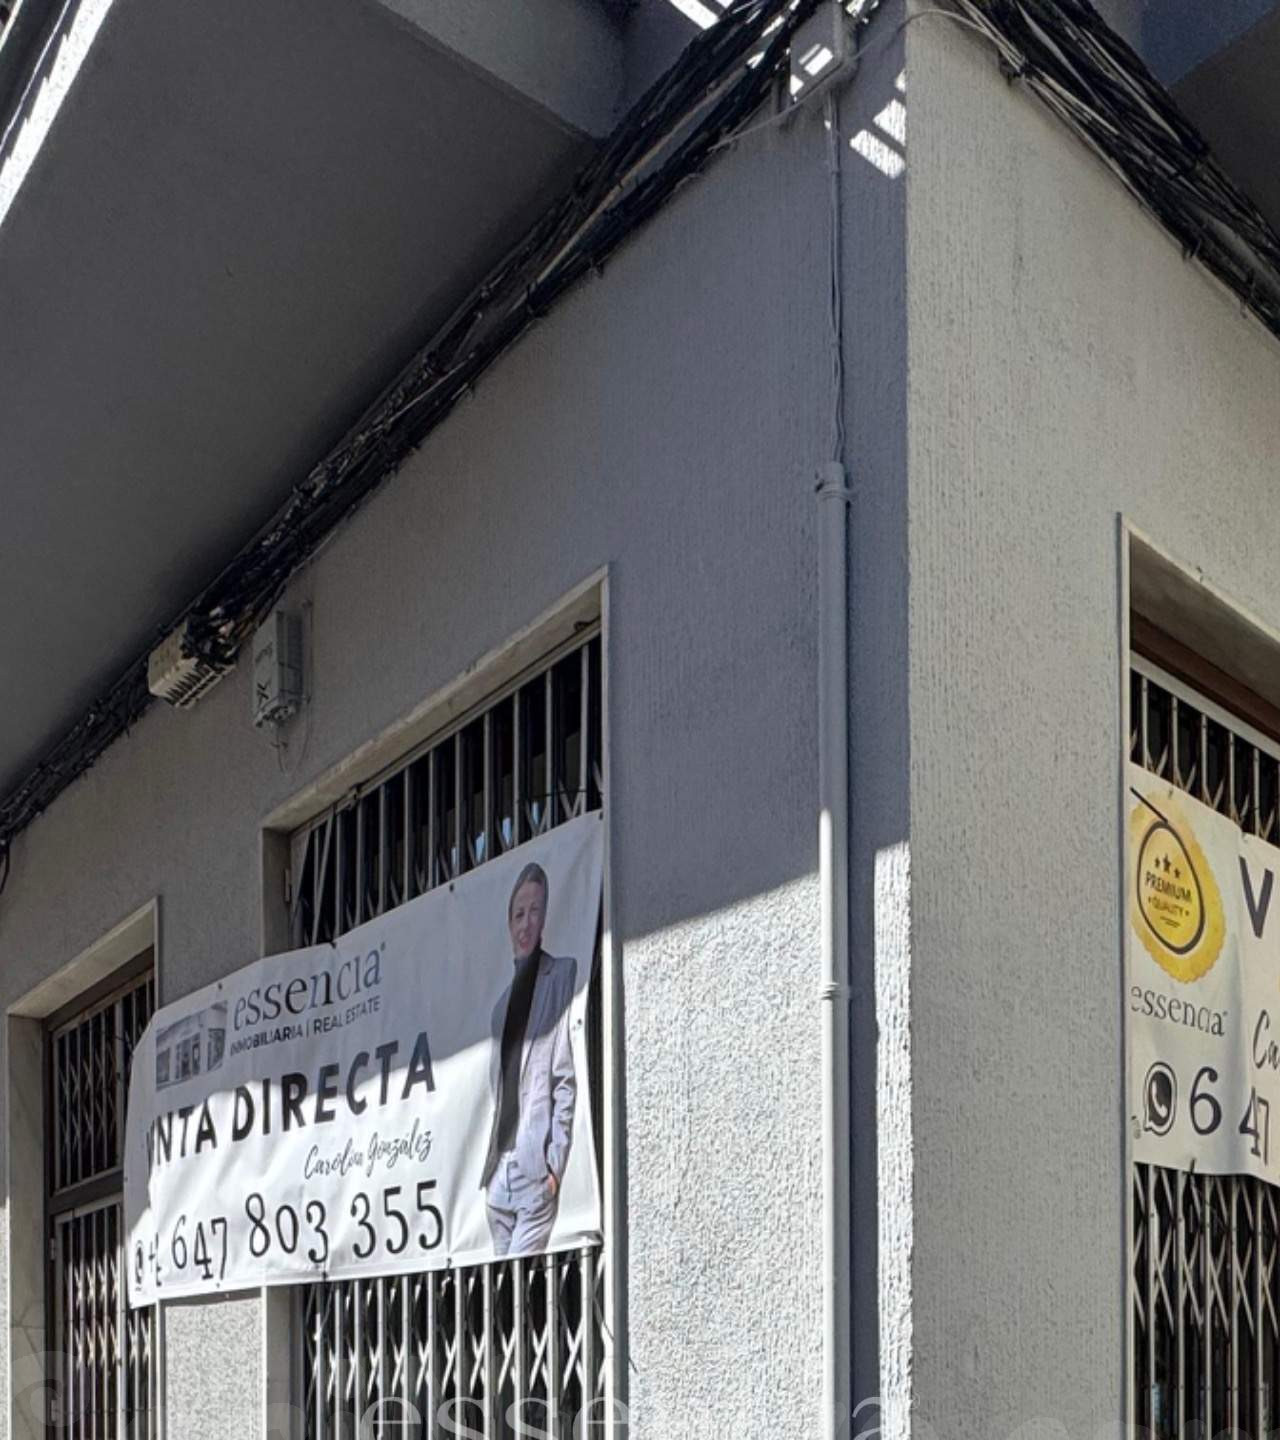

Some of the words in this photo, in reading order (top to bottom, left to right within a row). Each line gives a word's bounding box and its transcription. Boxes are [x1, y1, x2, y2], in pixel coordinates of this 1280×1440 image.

[1145, 870, 1192, 902] PREMIUM
[229, 1023, 304, 1056] INMOBILIARIA
[313, 1014, 344, 1034] REAL
[345, 995, 382, 1024] ESTATE
[233, 948, 384, 1032] essencia
[1130, 985, 1225, 1037] essencia
[231, 1031, 436, 1142] DIRECTA
[172, 1214, 228, 1281] 647
[245, 1192, 329, 1264] 803
[350, 1179, 444, 1259] 355
